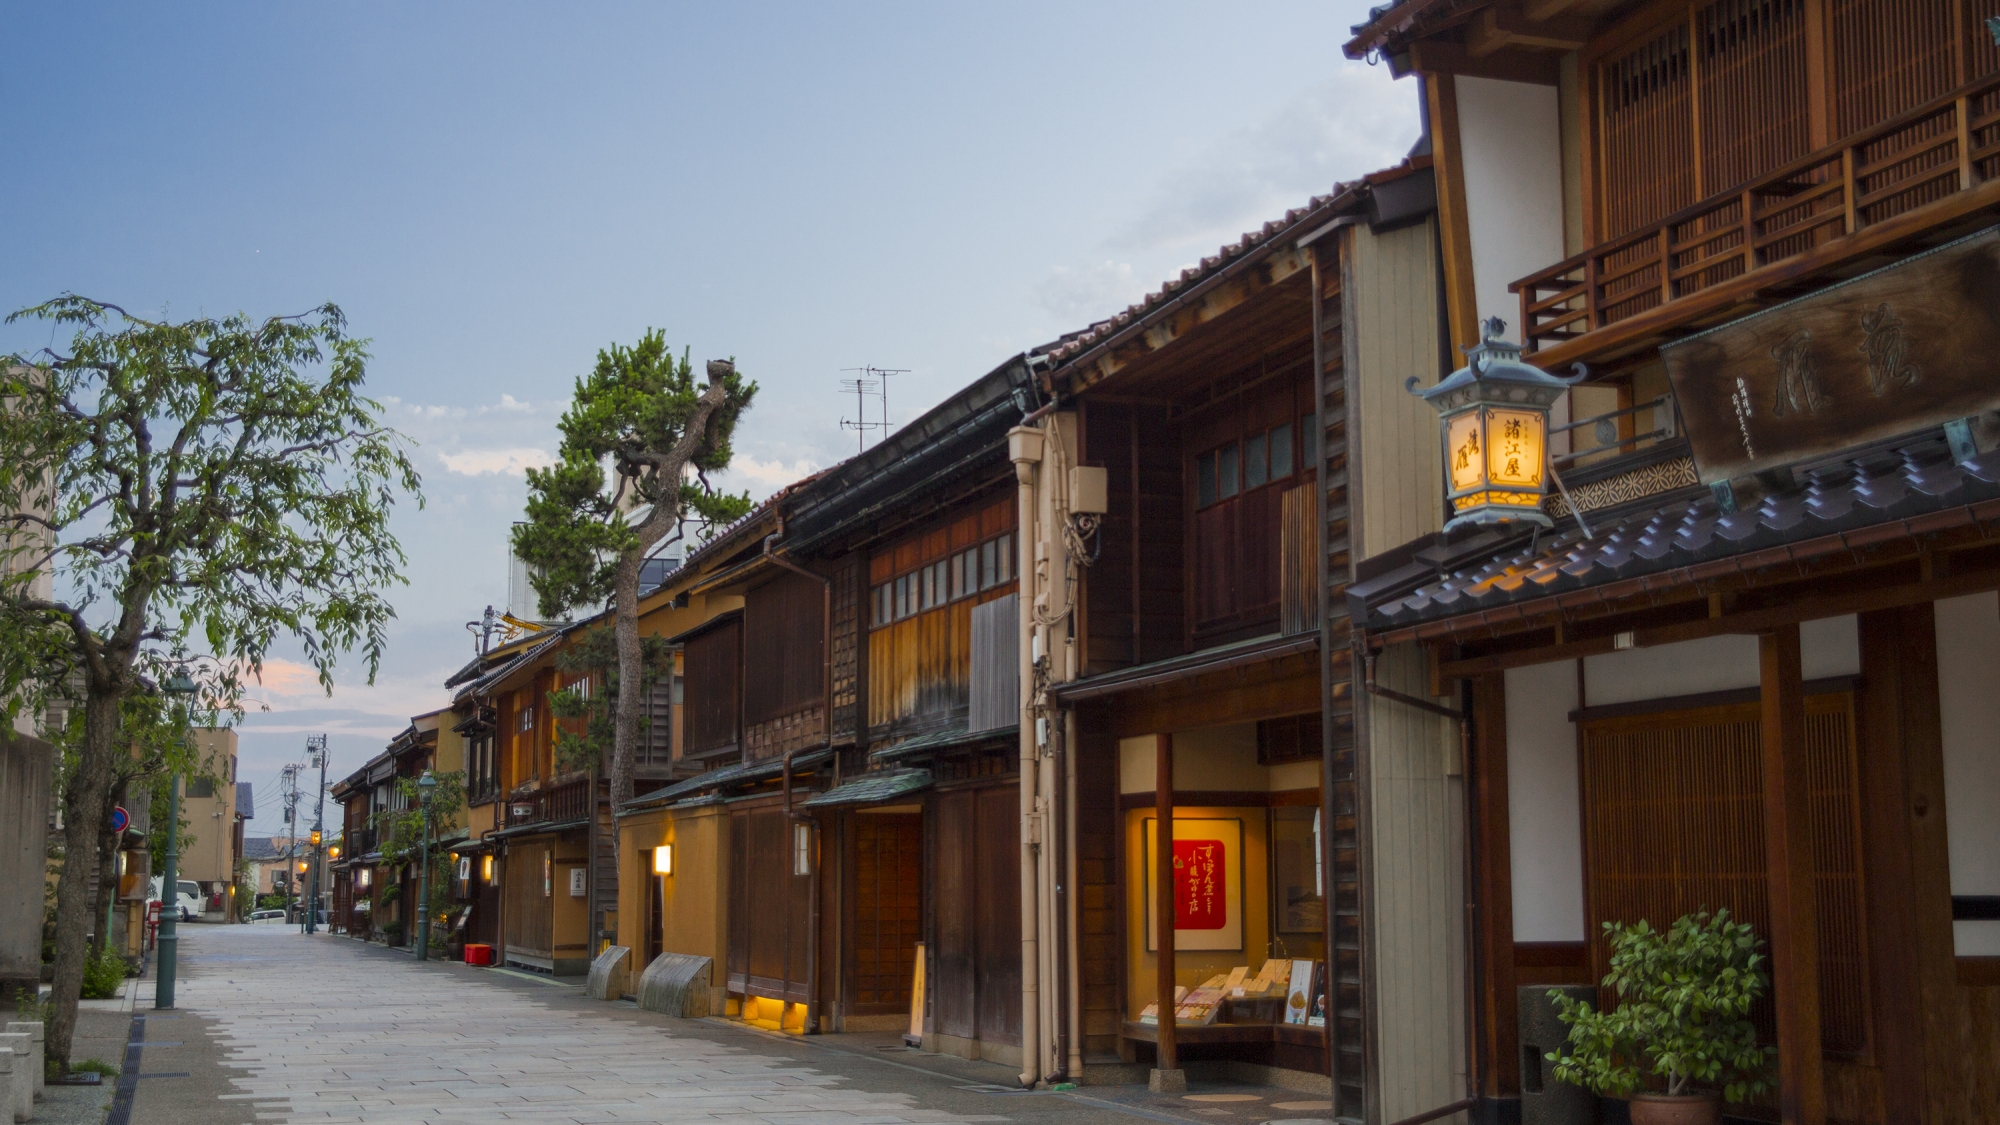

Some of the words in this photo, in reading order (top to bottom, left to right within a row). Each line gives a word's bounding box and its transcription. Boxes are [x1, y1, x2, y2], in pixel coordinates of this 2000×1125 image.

[1456, 427, 1479, 472] 落雁
[1504, 417, 1521, 477] 諸江屋
